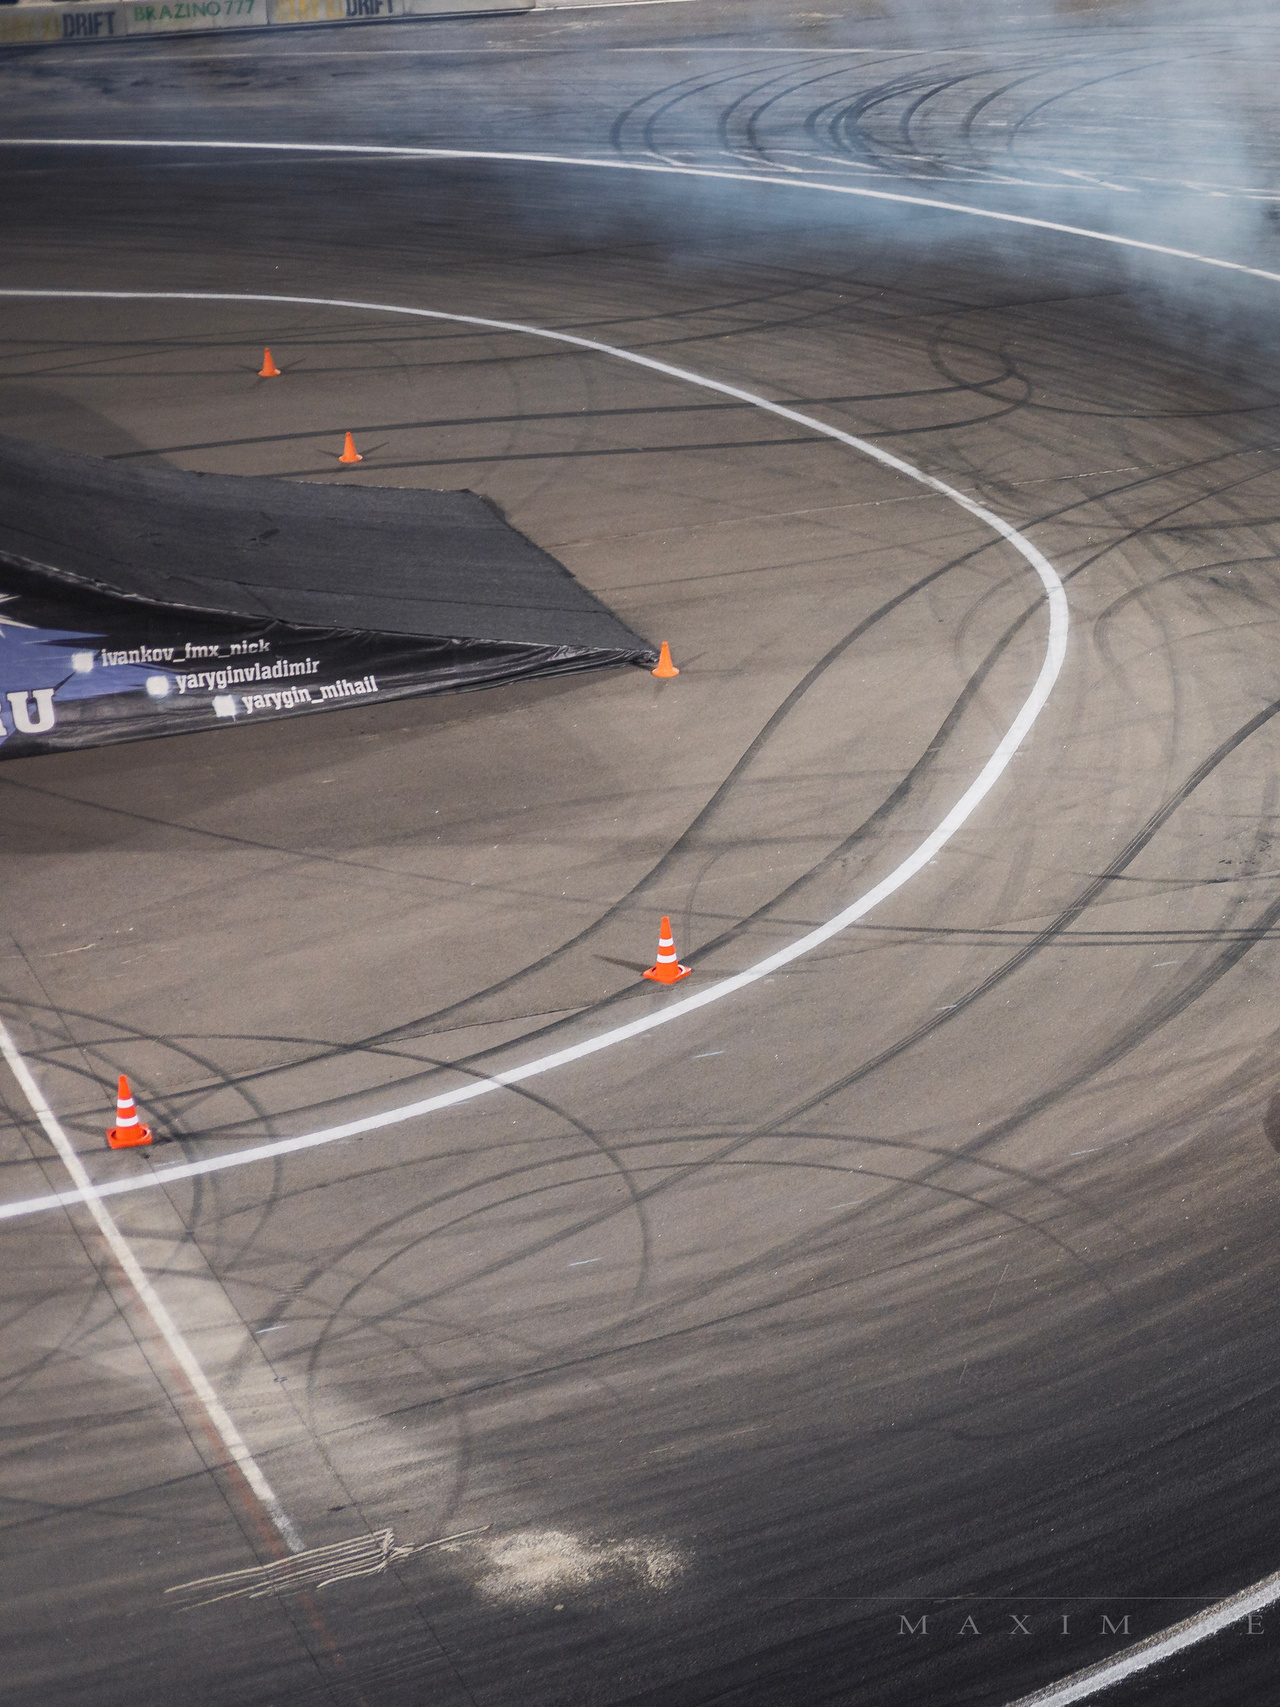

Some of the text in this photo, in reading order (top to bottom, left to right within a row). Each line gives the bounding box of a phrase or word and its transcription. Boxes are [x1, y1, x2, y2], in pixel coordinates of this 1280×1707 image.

[62, 11, 116, 38] DRIFT
[133, 1, 221, 22] BRAZINO
[175, 657, 320, 694] yaryginvladimir
[0, 687, 56, 736] U
[242, 675, 379, 715] yarygin_mihail
